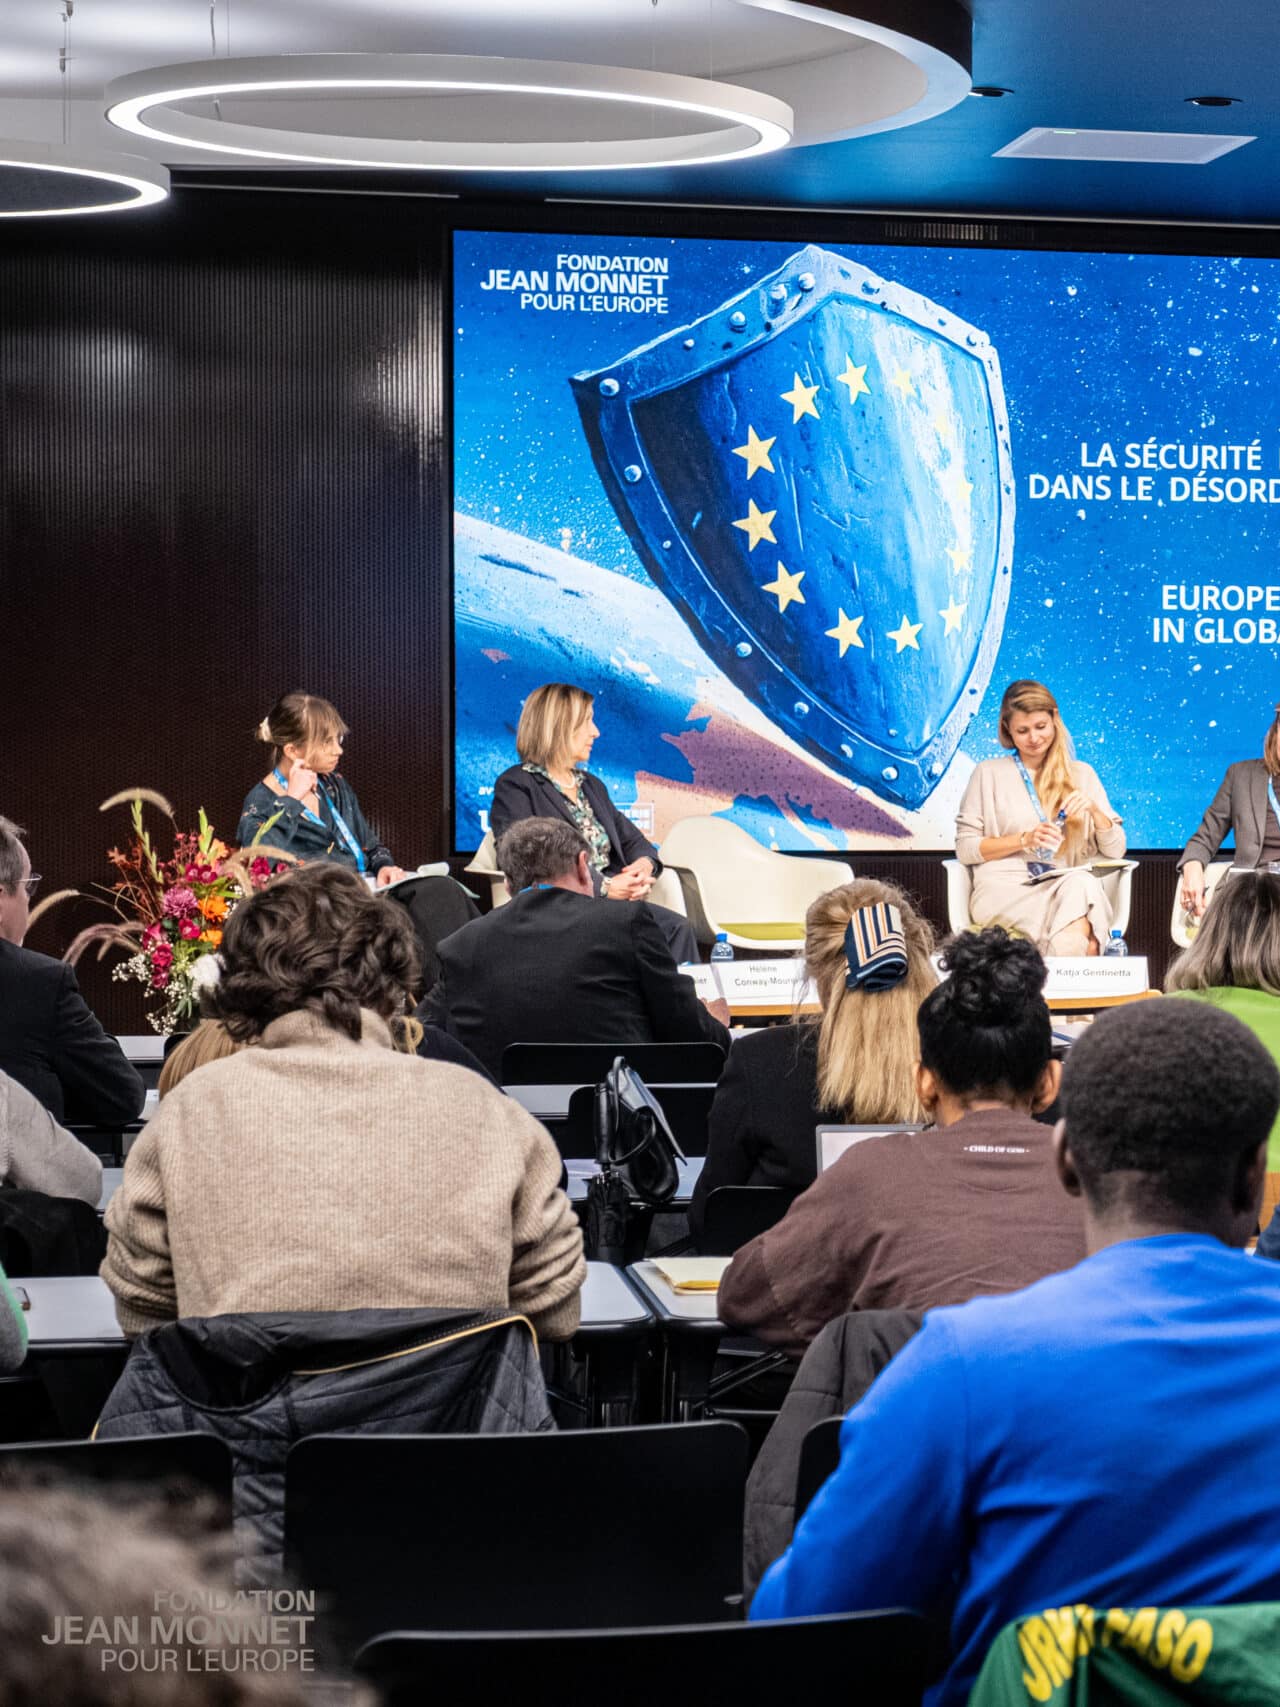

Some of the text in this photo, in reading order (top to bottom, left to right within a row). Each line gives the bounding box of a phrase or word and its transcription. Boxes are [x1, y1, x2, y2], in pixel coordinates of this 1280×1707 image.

[556, 254, 669, 273] FONDATION
[480, 269, 669, 295] JEAN MONNET
[521, 293, 575, 311] POUR
[1081, 442, 1117, 468] LA
[1124, 437, 1262, 471] SÉCURITÉ
[1029, 474, 1112, 500] DANS
[1121, 476, 1153, 500] LE
[1153, 618, 1185, 643] IN
[1056, 967, 1131, 978] Katja Gentinetta
